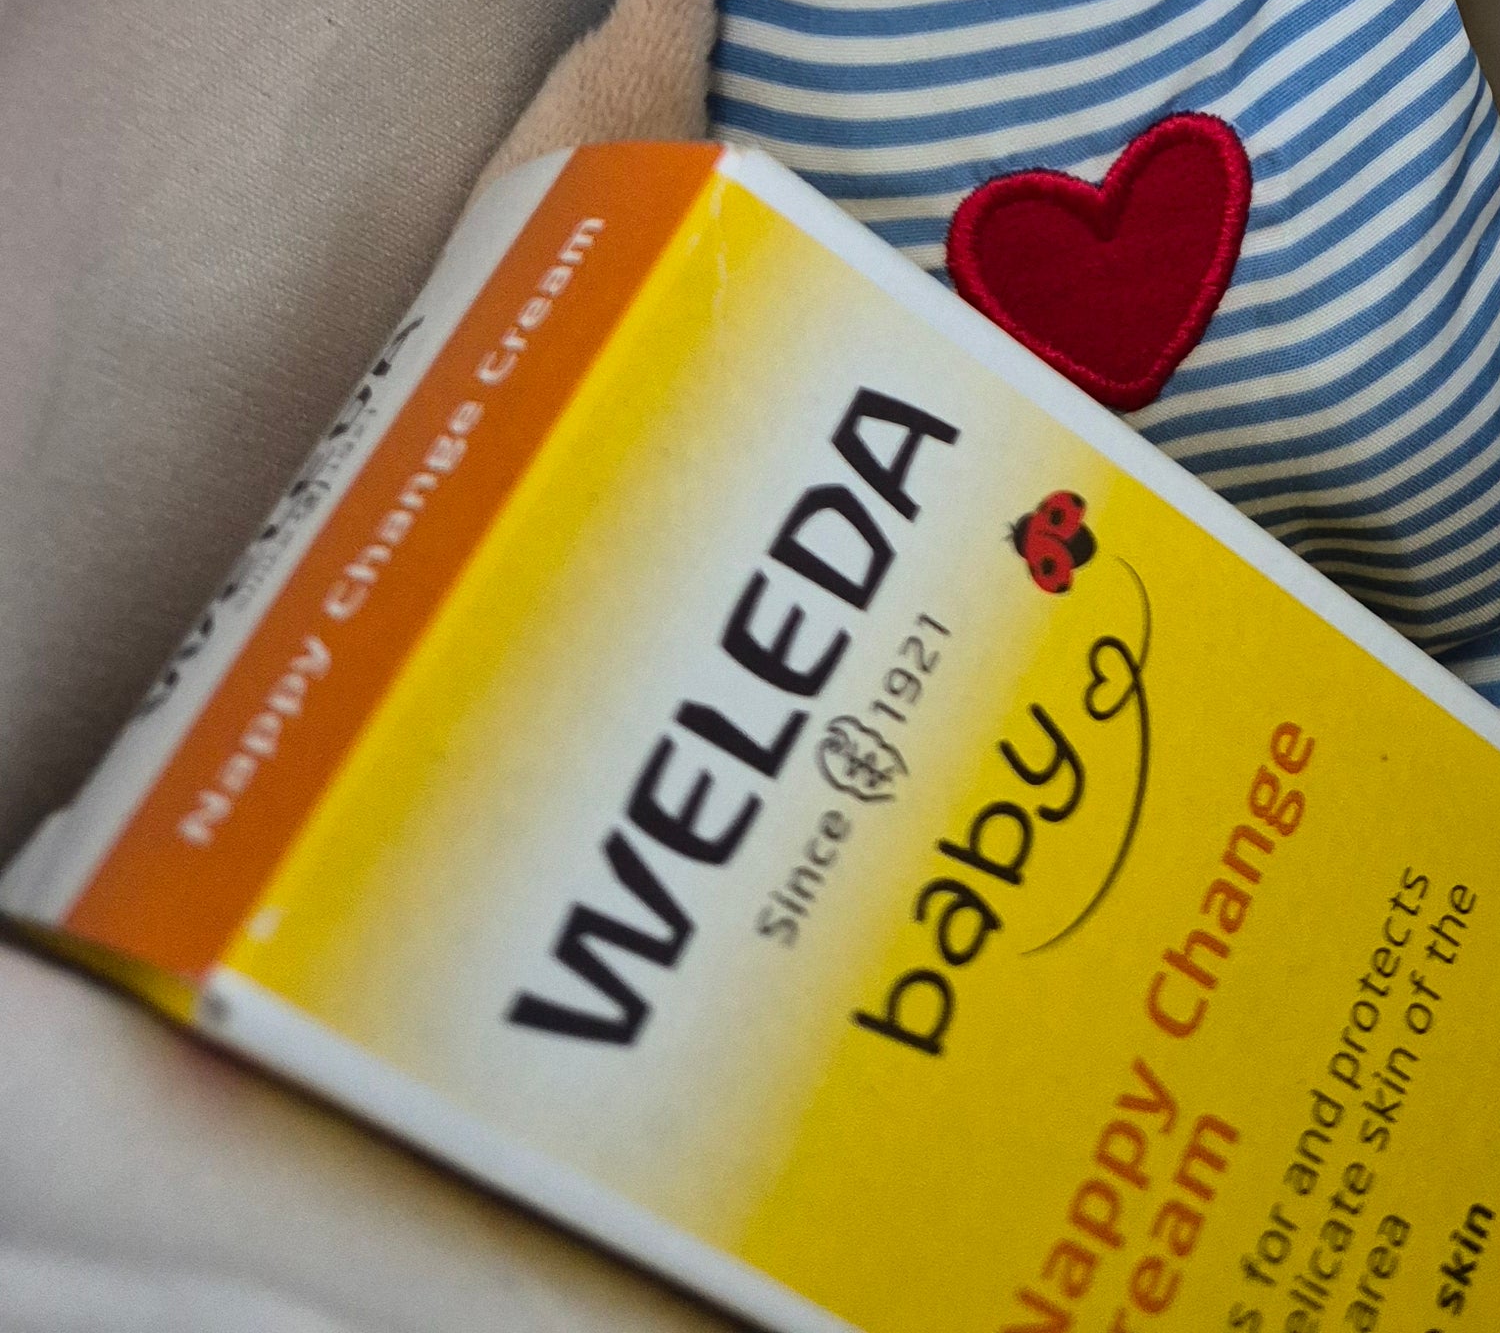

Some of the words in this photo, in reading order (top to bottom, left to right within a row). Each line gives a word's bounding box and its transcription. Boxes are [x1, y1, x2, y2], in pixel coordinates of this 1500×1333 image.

[178, 635, 332, 847] Nappy
[323, 400, 486, 621] Change
[476, 216, 606, 386] Cream
[506, 386, 961, 1049] WELEDA
[756, 809, 853, 949] Since
[872, 612, 952, 724] 1921
[851, 702, 1085, 1057] baby
[1144, 720, 1317, 1040] Change
[1105, 1113, 1240, 1333] eam
[1239, 1201, 1300, 1288] for
[1283, 1087, 1346, 1197] and
[1327, 865, 1430, 1091] protects
[1284, 1162, 1375, 1333] elicate
[1358, 1046, 1420, 1152] skin
[1404, 969, 1442, 1035] of
[1425, 882, 1478, 966] the
[1344, 1213, 1412, 1333] area
[1436, 1203, 1497, 1317] skin
